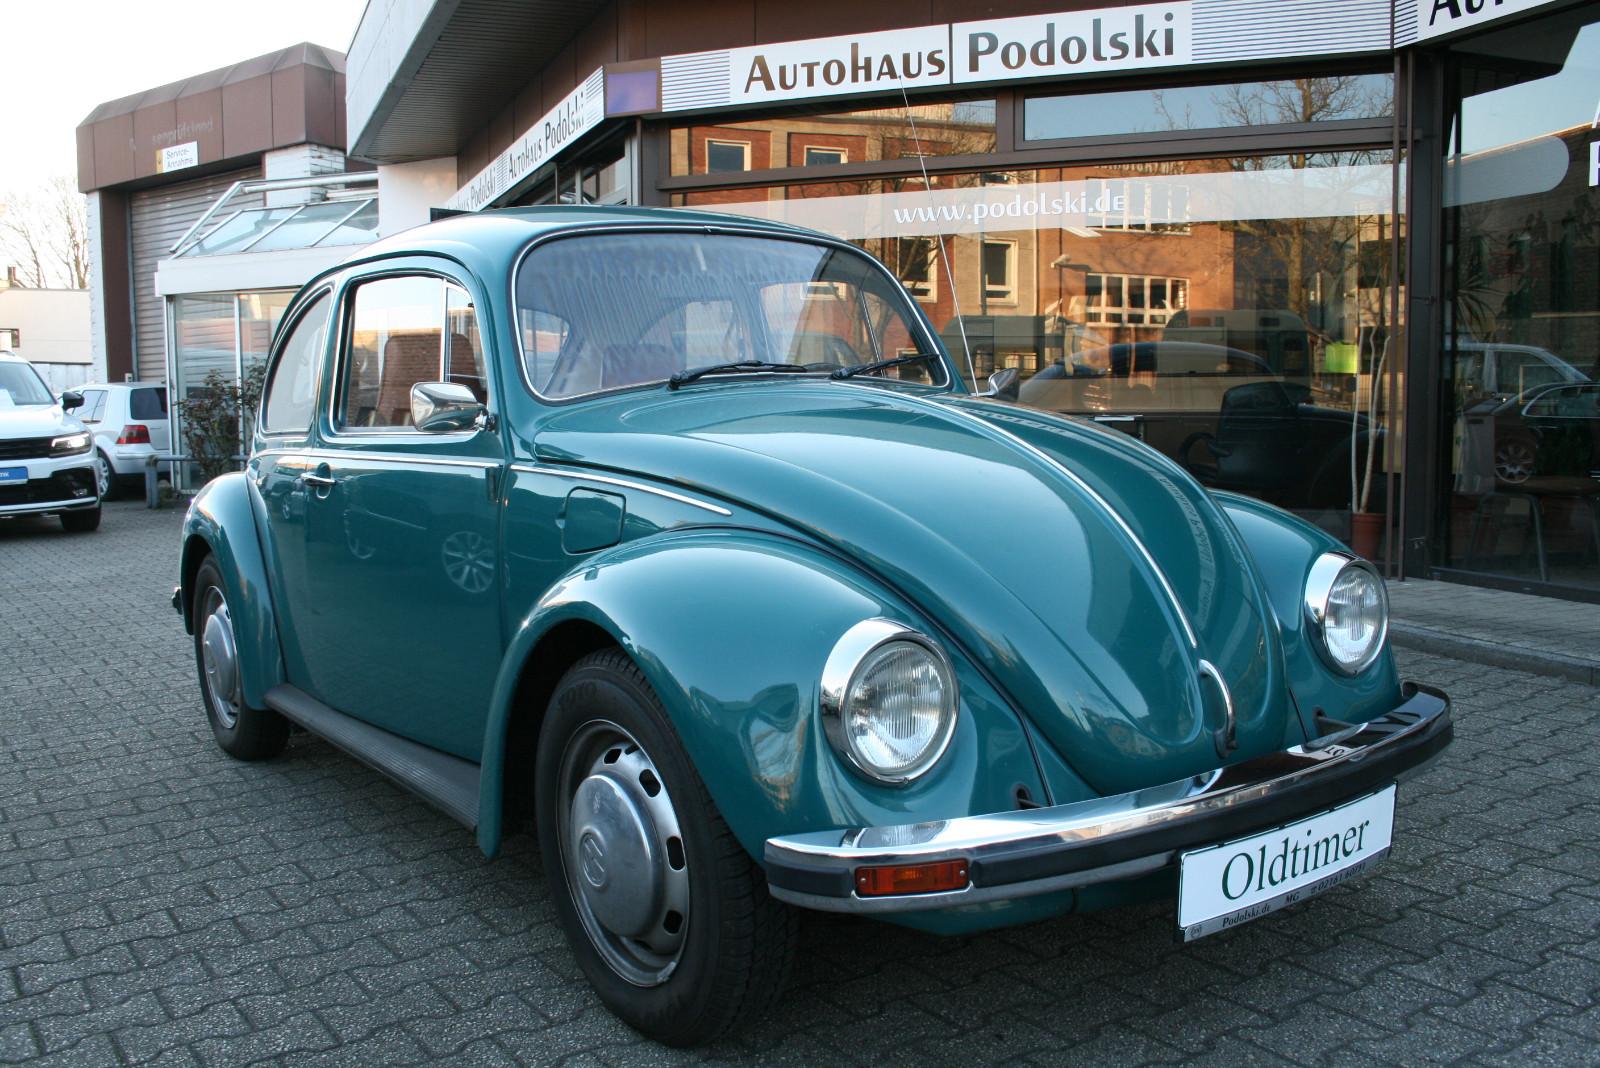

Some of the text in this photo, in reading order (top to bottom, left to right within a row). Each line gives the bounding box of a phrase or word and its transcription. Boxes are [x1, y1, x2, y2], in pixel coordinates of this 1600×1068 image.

[968, 12, 1175, 73] Podolski
[1221, 820, 1370, 901] Oldtimer
[1222, 903, 1271, 928] Podolski.de
